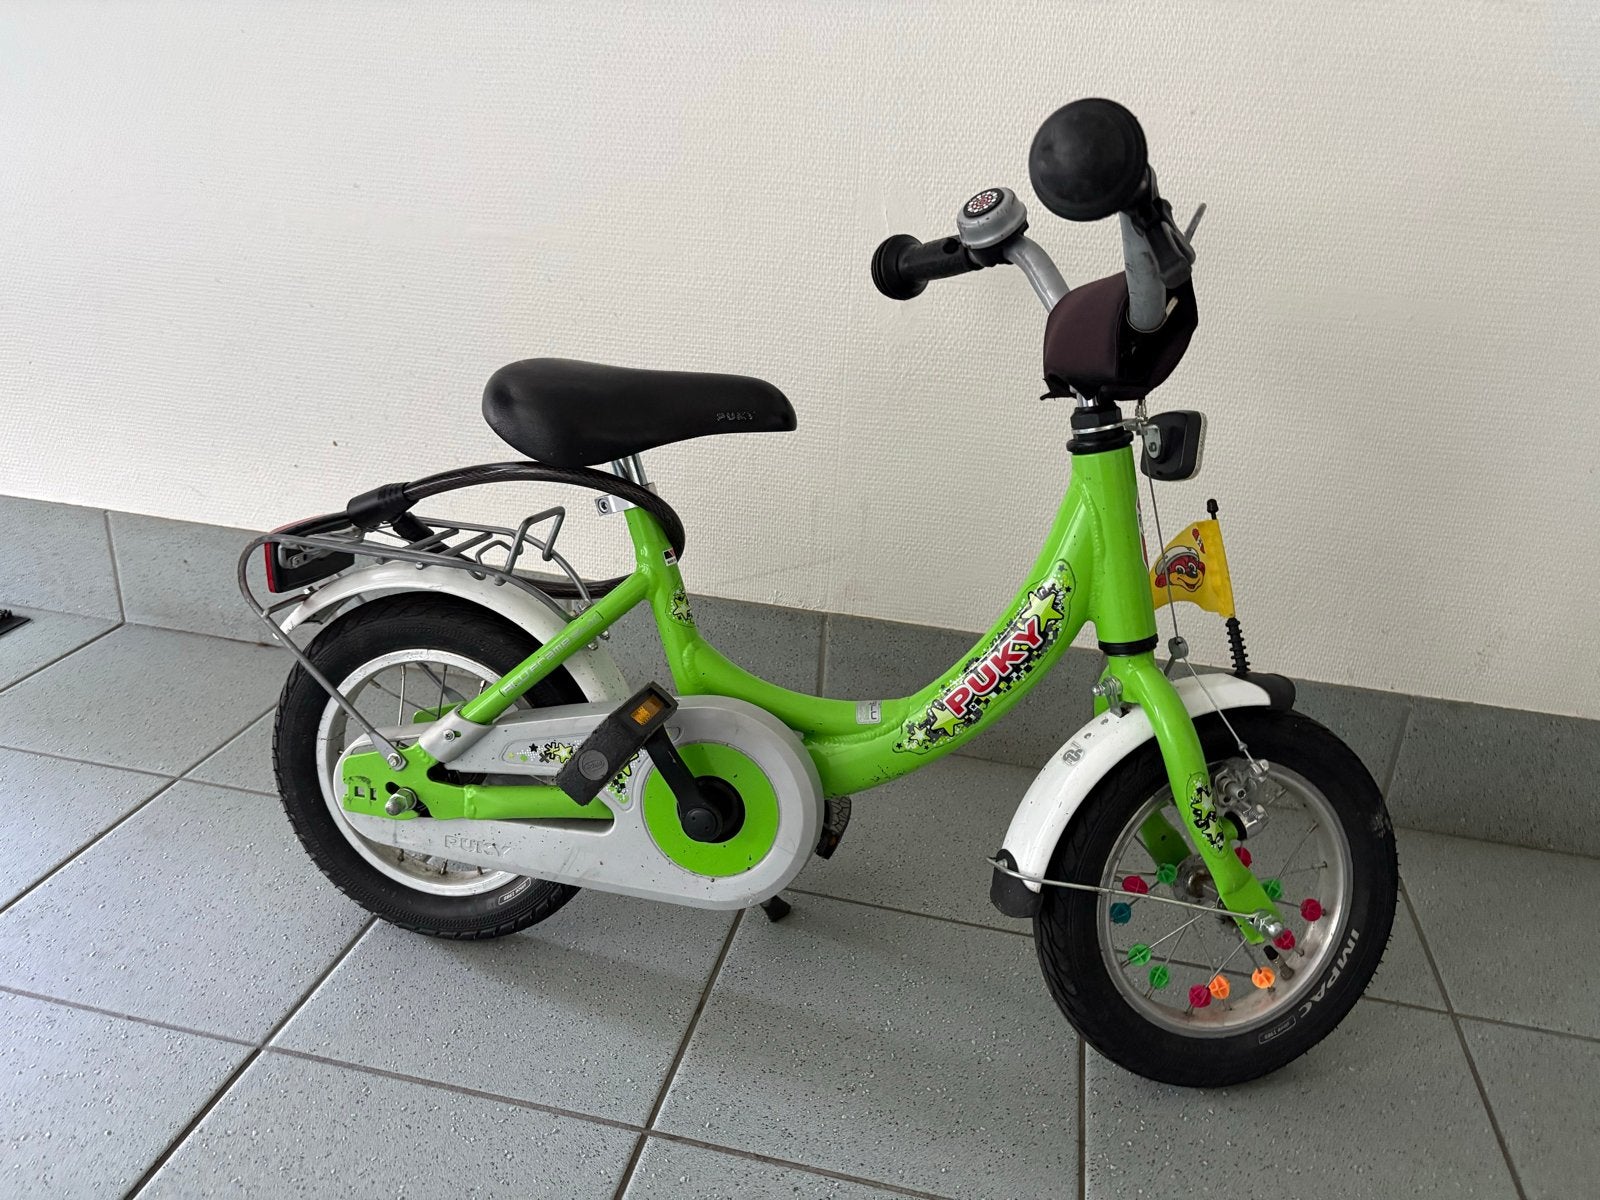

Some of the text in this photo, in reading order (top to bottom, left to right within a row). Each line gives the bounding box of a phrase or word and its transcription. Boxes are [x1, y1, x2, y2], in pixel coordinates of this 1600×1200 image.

[715, 410, 755, 421] PUKY
[943, 616, 1043, 718] PUKY
[444, 834, 512, 858] PUKY
[1299, 928, 1360, 1018] IMPAC
